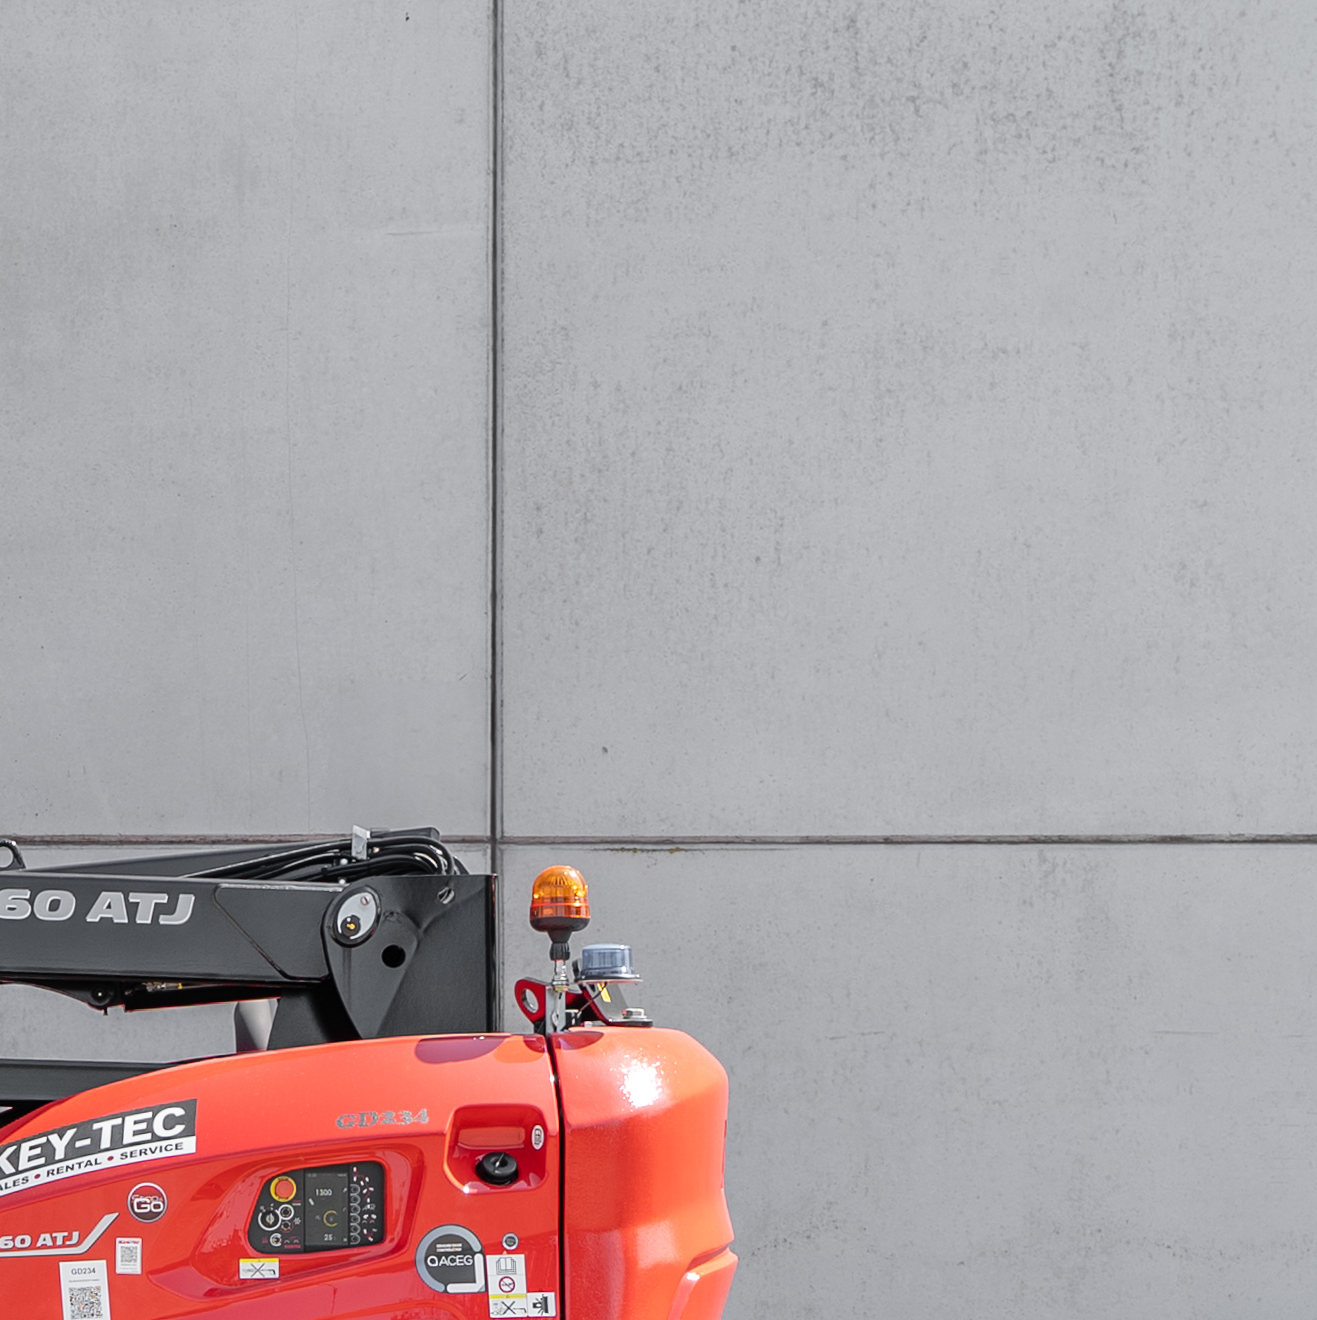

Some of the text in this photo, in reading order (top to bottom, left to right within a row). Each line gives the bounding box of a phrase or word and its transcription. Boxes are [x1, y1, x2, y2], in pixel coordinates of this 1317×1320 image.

[85, 891, 196, 926] ATJ
[335, 1108, 430, 1130] GD234
[45, 1156, 103, 1179] RENTAL
[119, 1141, 185, 1161] SERVICE
[35, 1230, 81, 1248] ATJ
[70, 1267, 97, 1276] GD234
